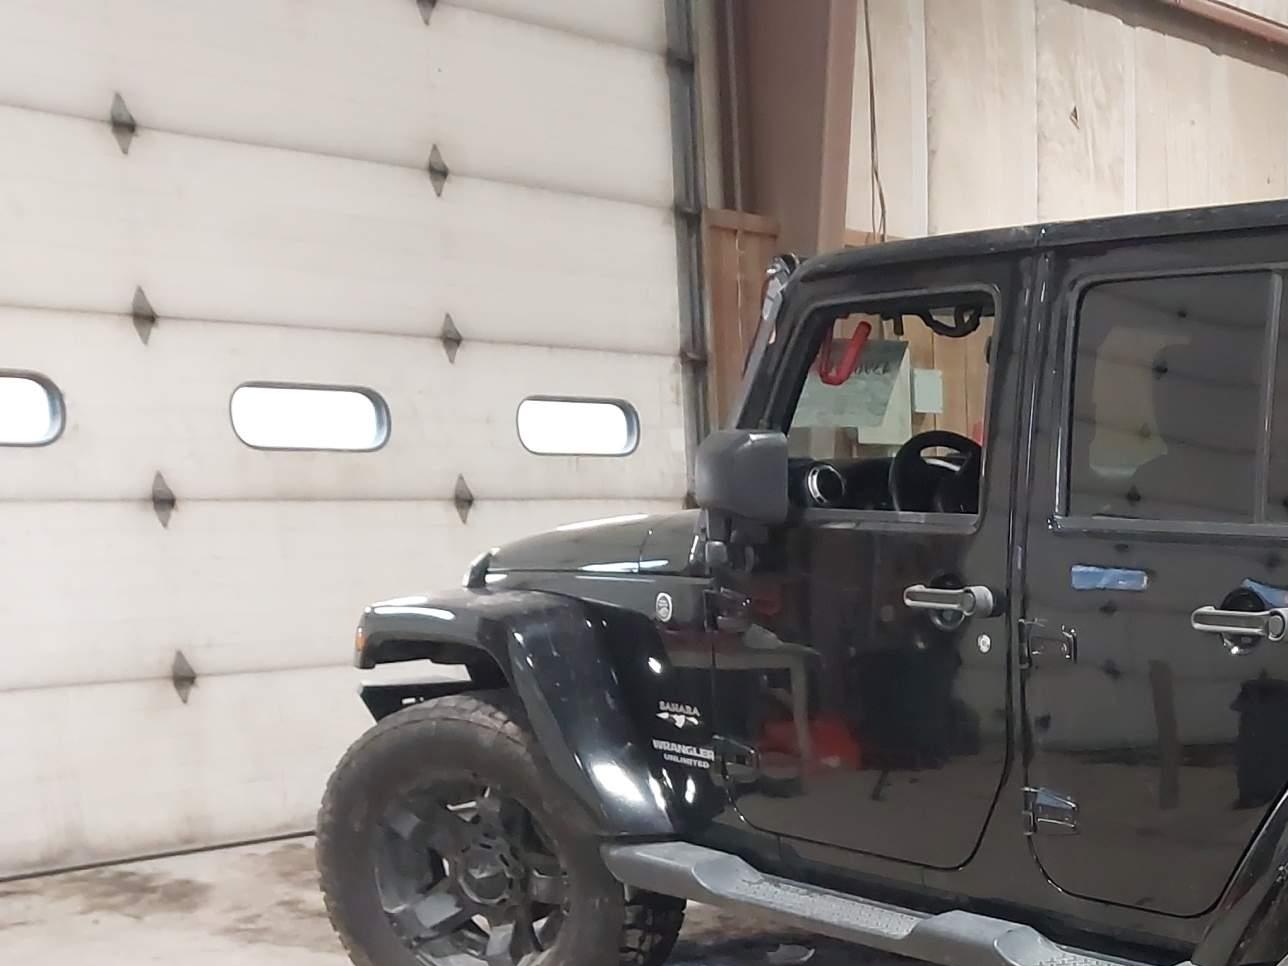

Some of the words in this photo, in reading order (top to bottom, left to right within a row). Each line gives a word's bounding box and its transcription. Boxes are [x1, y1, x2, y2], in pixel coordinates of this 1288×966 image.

[659, 701, 700, 717] SAHARA
[652, 739, 715, 761] WRANGLER
[663, 753, 710, 768] UNLIMITED
